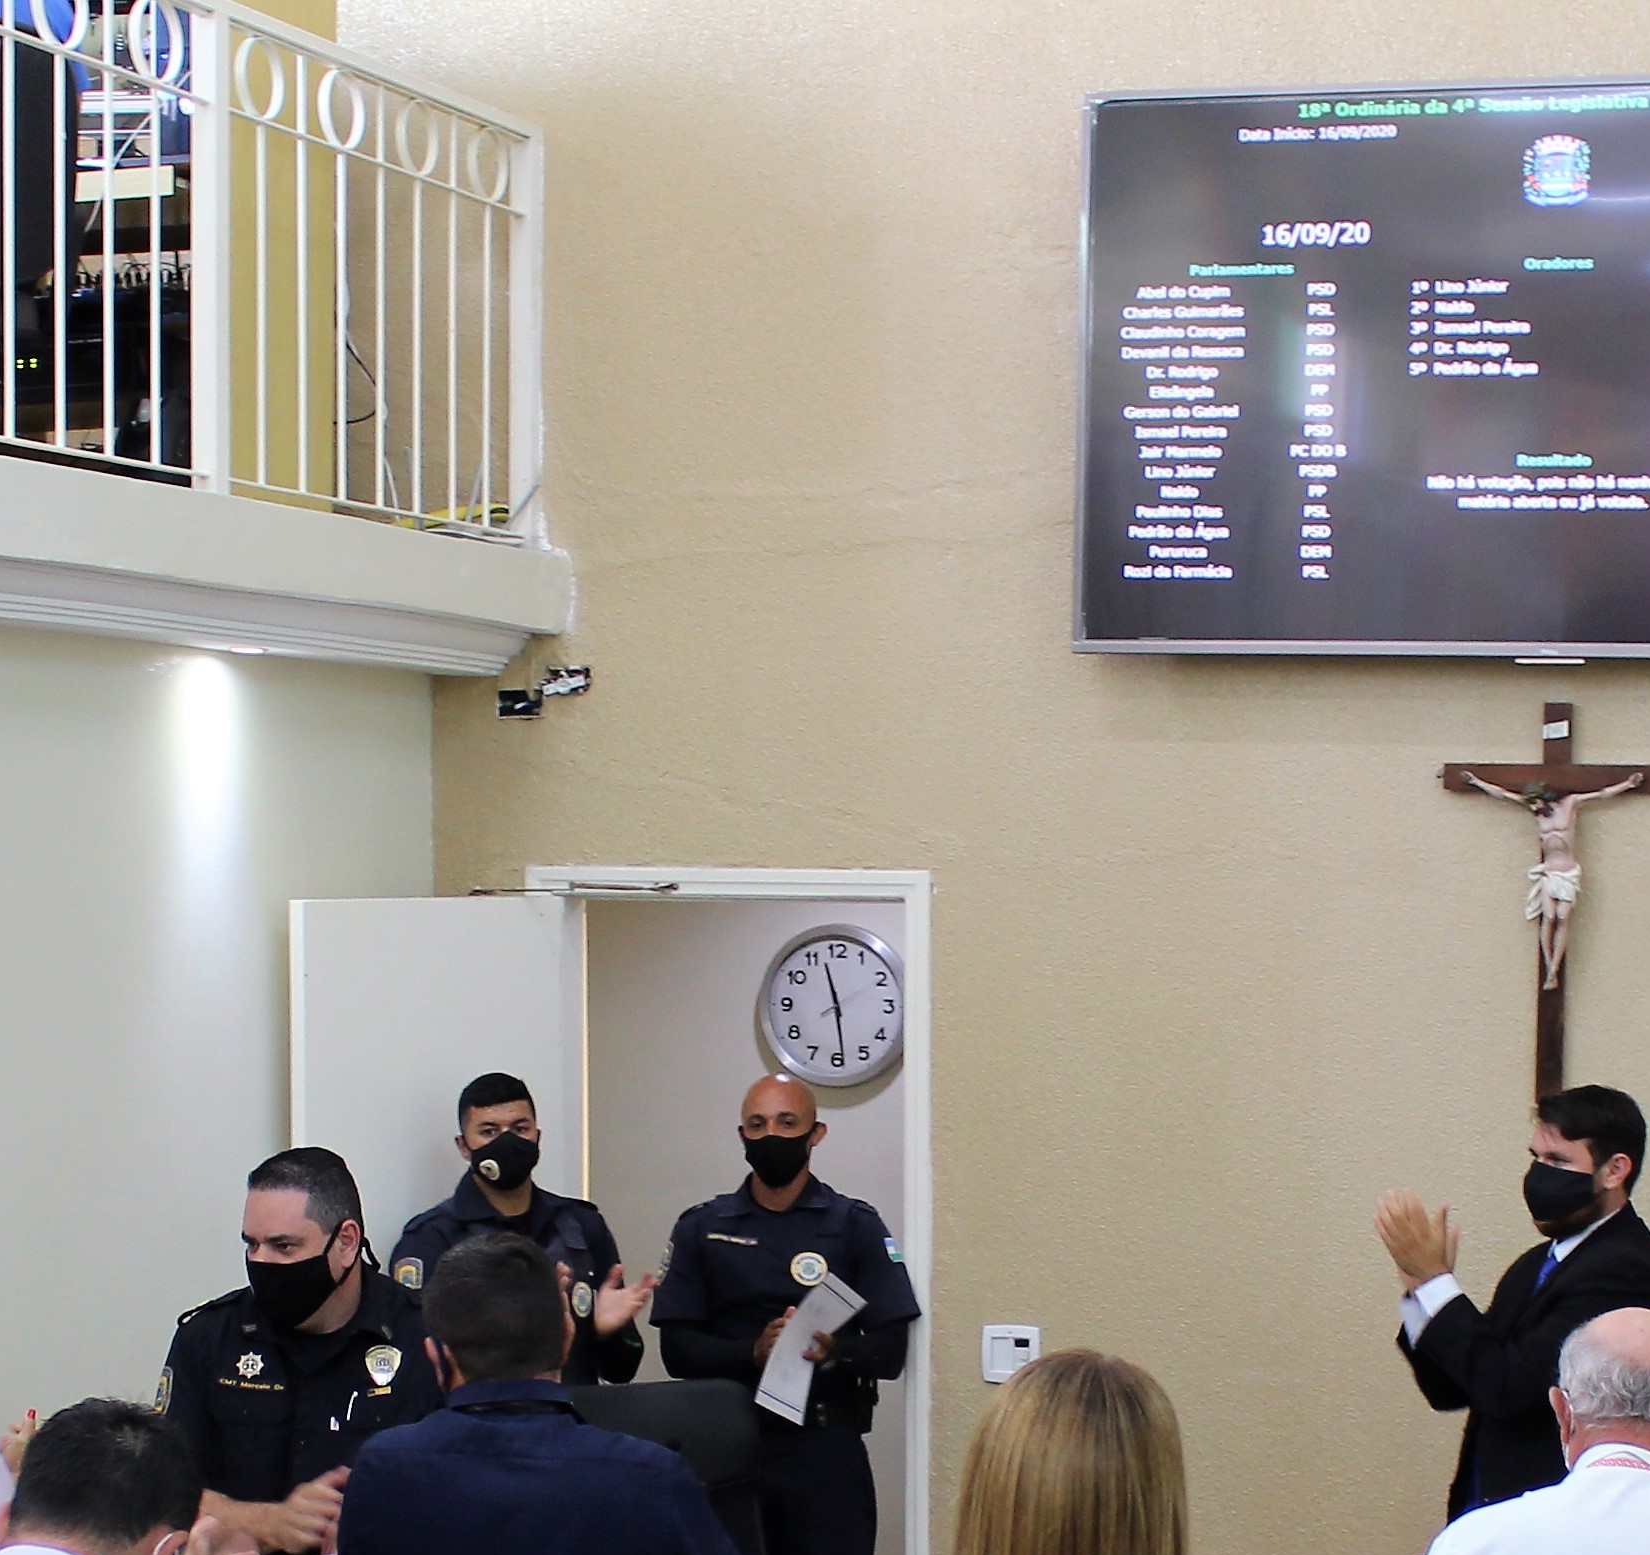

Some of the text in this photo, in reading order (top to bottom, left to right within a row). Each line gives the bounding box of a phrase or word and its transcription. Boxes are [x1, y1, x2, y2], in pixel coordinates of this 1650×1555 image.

[1335, 100, 1420, 117] Ordinária
[1424, 100, 1448, 115] da
[1453, 98, 1474, 113] 4ª
[1479, 97, 1544, 113] Sessão
[1549, 94, 1649, 112] Legislativa
[1238, 128, 1272, 142] Data
[1318, 124, 1397, 141] 16/09/2020
[1262, 221, 1371, 248] 16/09/20
[1189, 263, 1295, 276] Parlamentares
[1523, 256, 1594, 271] Oradores
[1137, 286, 1167, 299] Abel
[1306, 282, 1337, 297] PSD
[1123, 304, 1244, 319] Charles Guimarães
[1307, 302, 1335, 317] PSL
[1306, 323, 1336, 337] PSD
[1305, 343, 1335, 357] PSD
[1304, 364, 1336, 377] DEM
[1304, 404, 1334, 417] PSD
[1304, 424, 1333, 437] PSD
[1516, 453, 1593, 467] Resultado
[1298, 463, 1338, 478] PSDB
[1302, 504, 1331, 519] PSL
[1301, 524, 1332, 539] PSD
[1301, 564, 1330, 579] PSL
[828, 943, 848, 959] 12
[858, 952, 865, 965] 1
[805, 952, 818, 966] 11
[787, 971, 806, 985] 10
[875, 972, 887, 987] 2
[781, 997, 793, 1012] 9
[883, 999, 895, 1014] 3
[788, 1025, 801, 1040] 8
[875, 1028, 887, 1041] 4
[806, 1046, 819, 1061] 7
[831, 1053, 844, 1067] 6
[858, 1046, 870, 1061] 5
